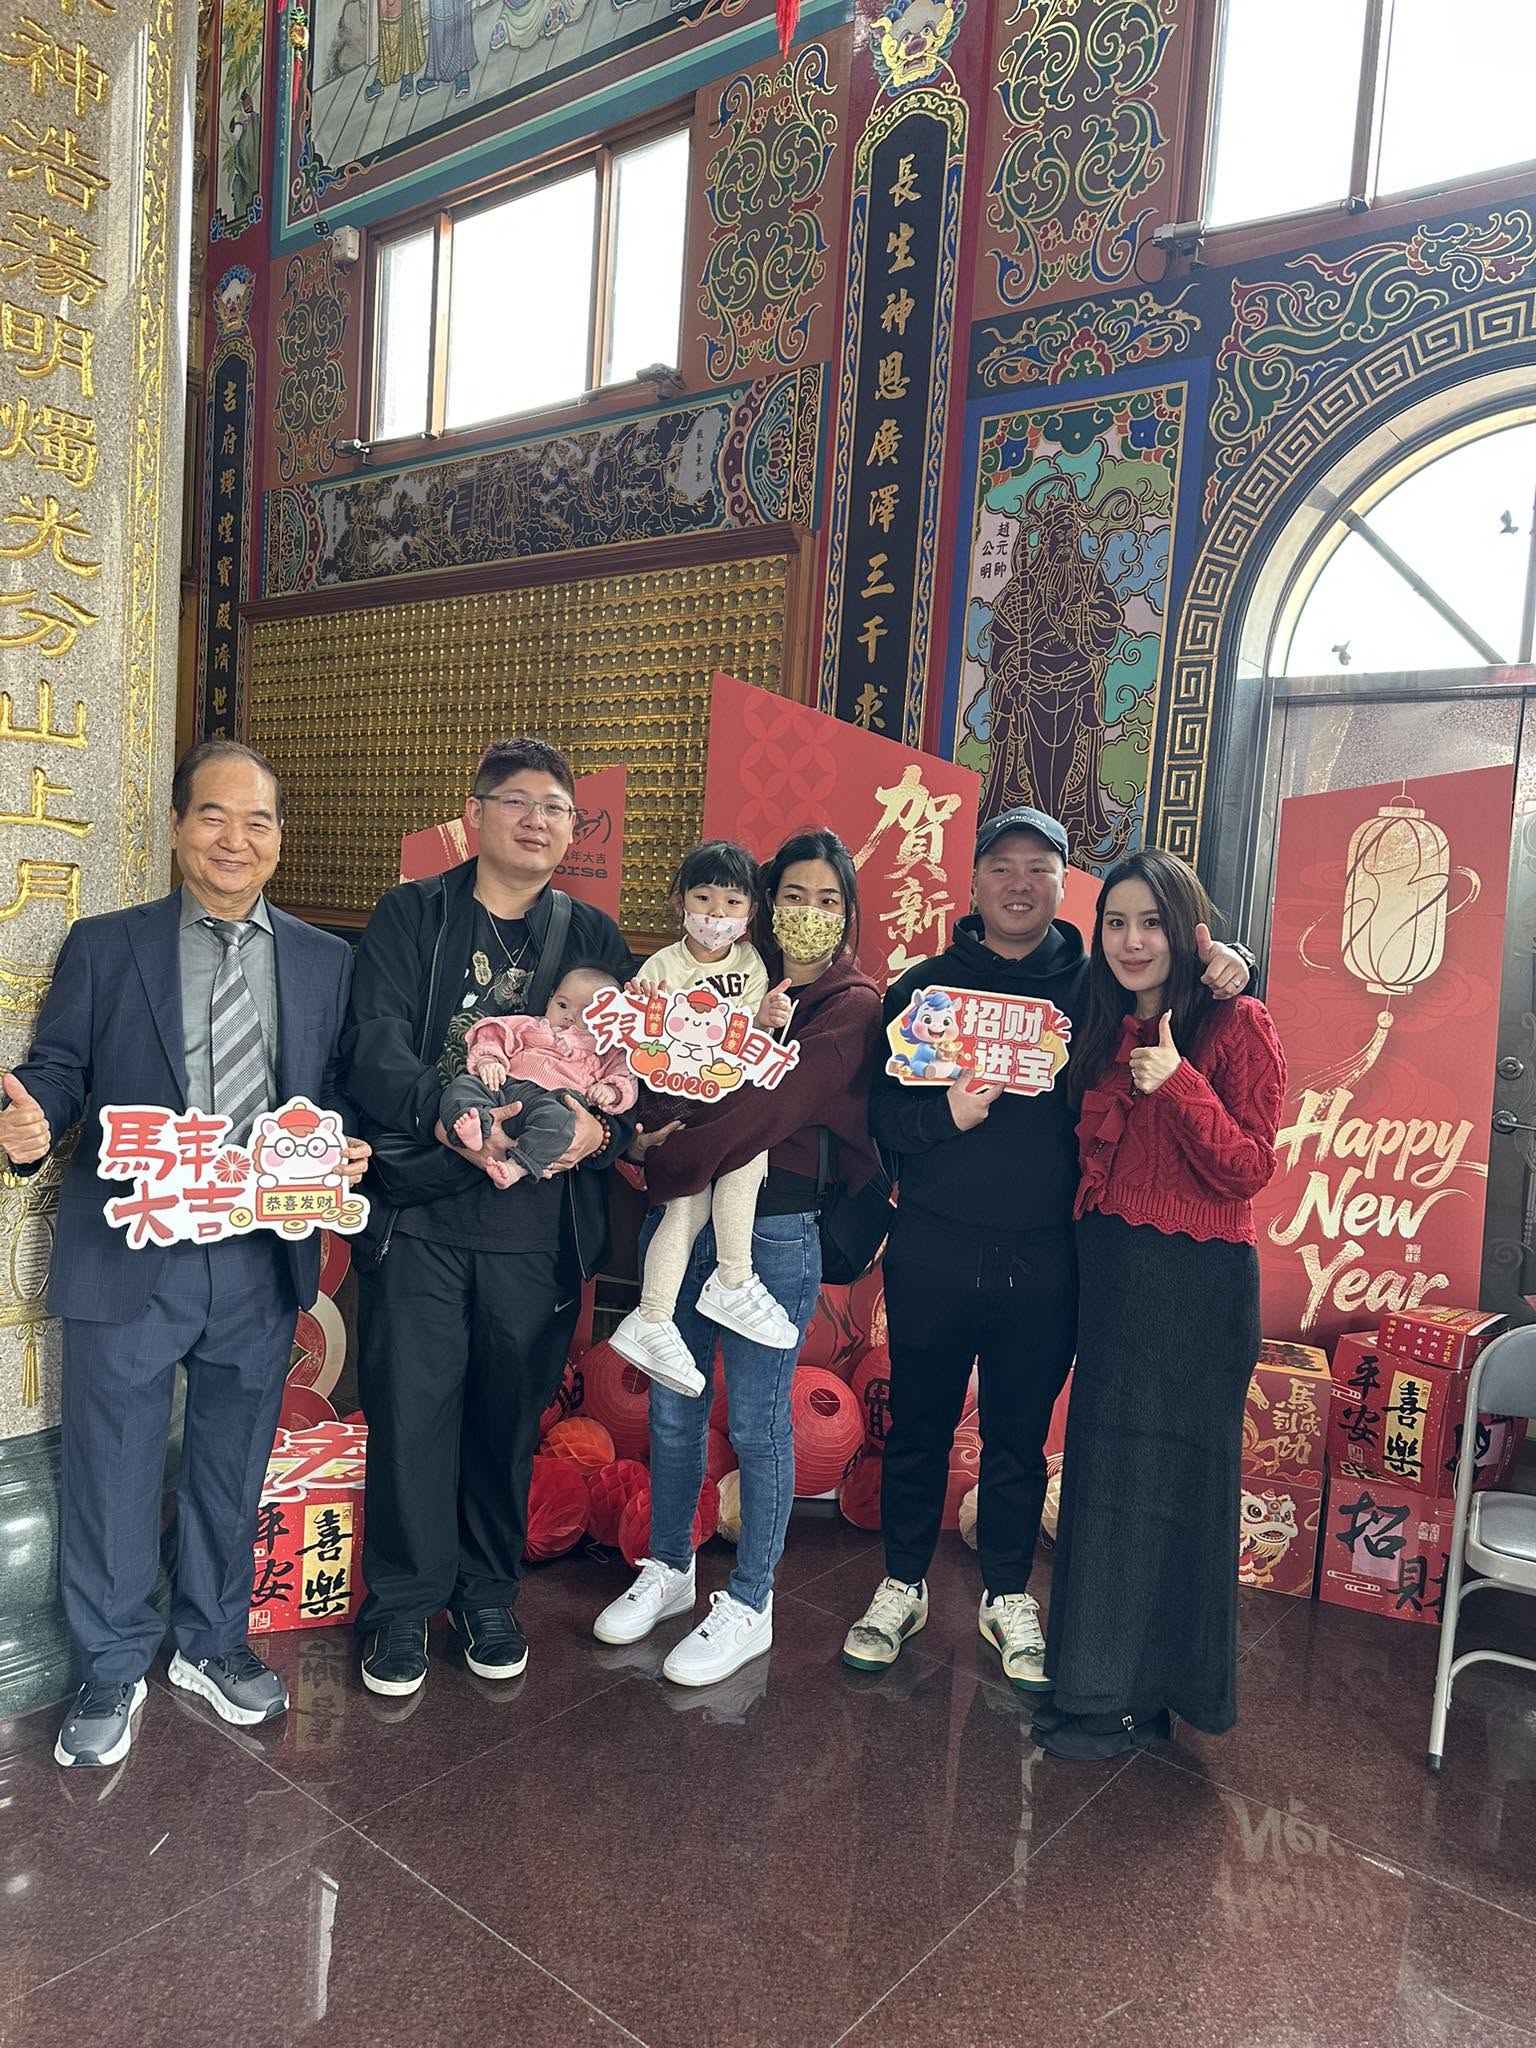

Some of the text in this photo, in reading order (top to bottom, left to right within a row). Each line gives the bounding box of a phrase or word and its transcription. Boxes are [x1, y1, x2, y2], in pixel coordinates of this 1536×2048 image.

[0, 0, 117, 926] 神浩蕩明燭光分山上月
[980, 541, 994, 579] 公明
[563, 851, 606, 864] 年大吉
[963, 999, 1045, 1044] 招财
[651, 1071, 718, 1098] 2026
[974, 1042, 1055, 1088] 进宝
[107, 1111, 226, 1182] 馬年
[1275, 1087, 1486, 1189] Happy
[112, 1180, 246, 1243] 大吉
[266, 1195, 334, 1212] 恭喜发财
[1268, 1167, 1473, 1245] New
[1295, 1240, 1449, 1336] Year
[1339, 1356, 1381, 1448] 平安
[1382, 1380, 1427, 1477] 喜樂
[294, 1509, 354, 1620] 喜樂
